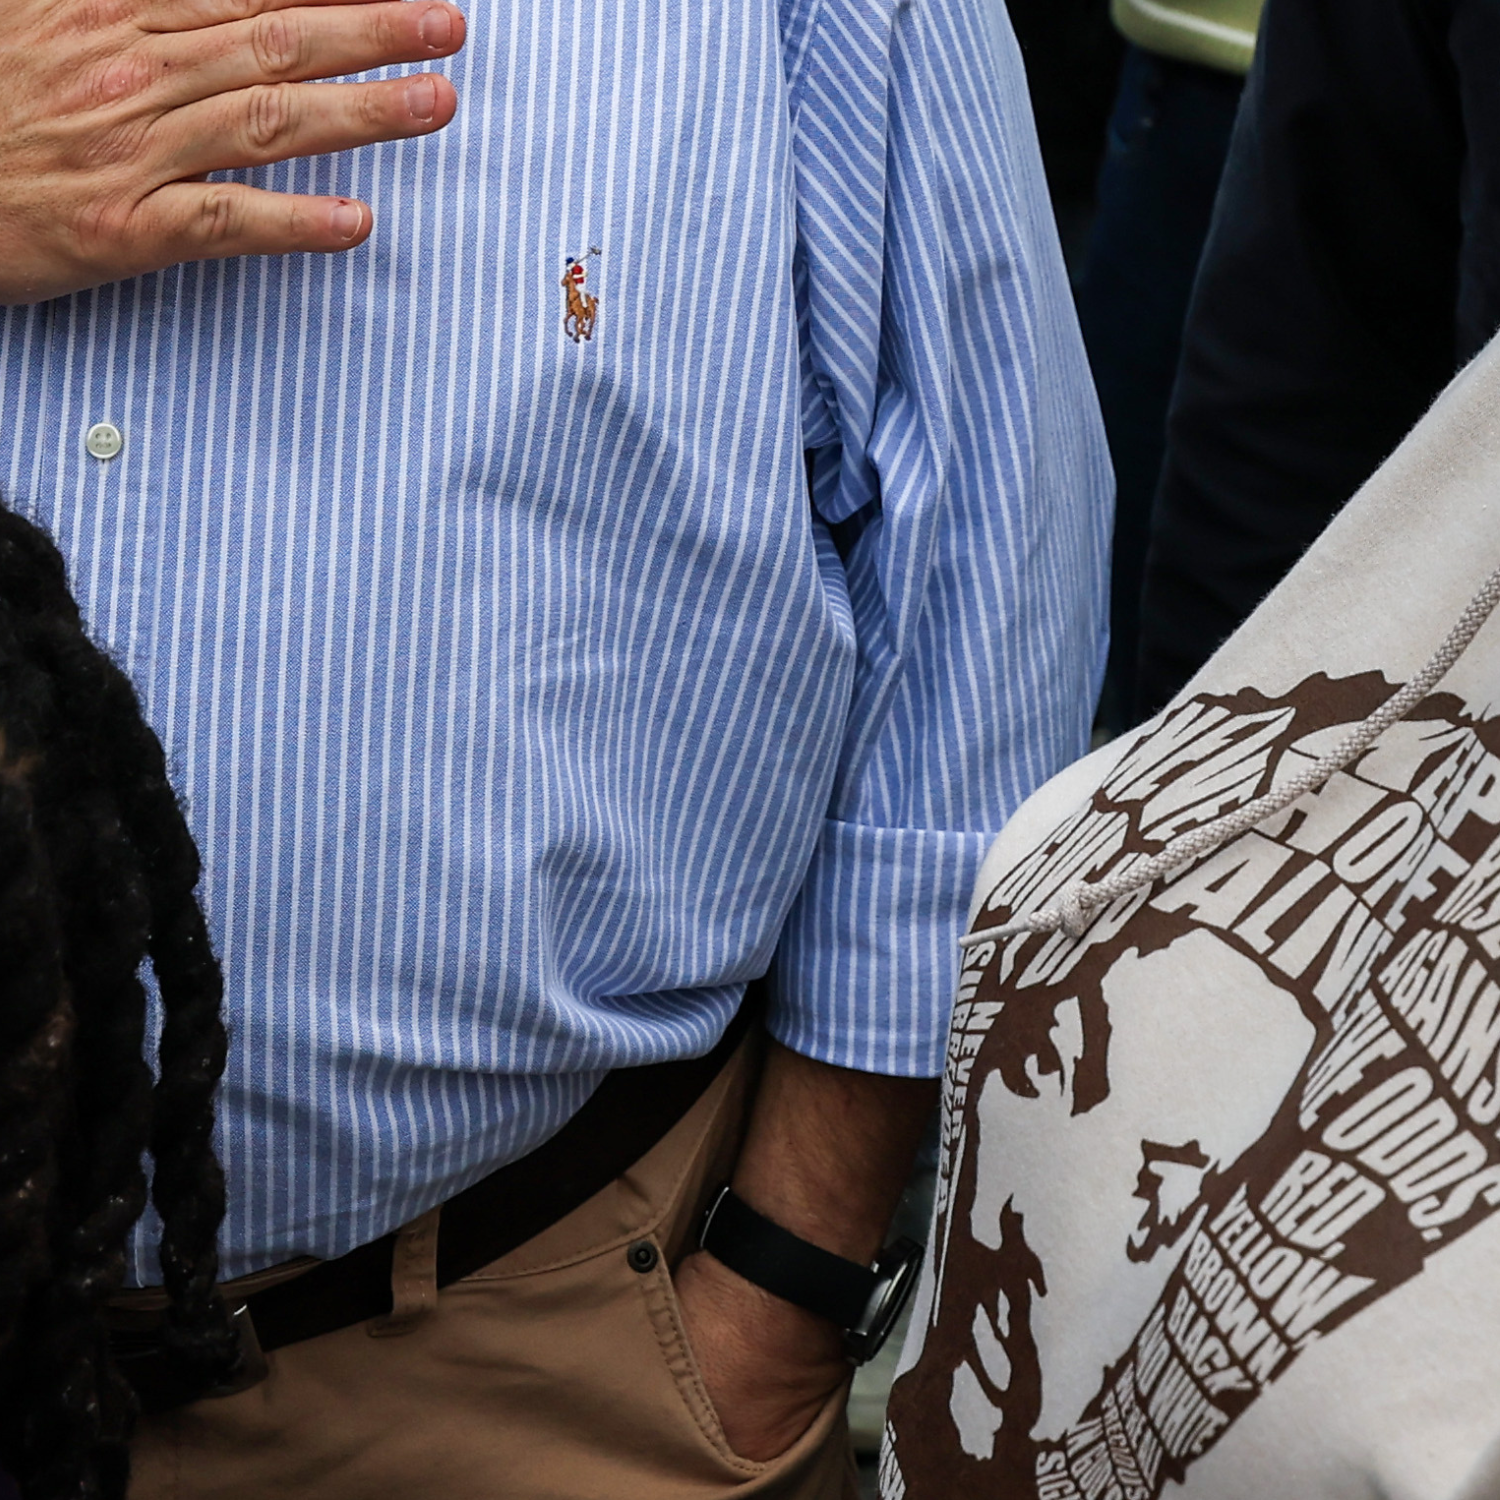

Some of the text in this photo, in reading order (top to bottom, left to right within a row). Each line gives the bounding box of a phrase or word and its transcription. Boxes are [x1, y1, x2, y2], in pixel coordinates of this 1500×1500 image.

[1149, 829, 1395, 1032] ALIVE
[1259, 1150, 1386, 1261] RED,
[1167, 1286, 1252, 1397] BLACK
